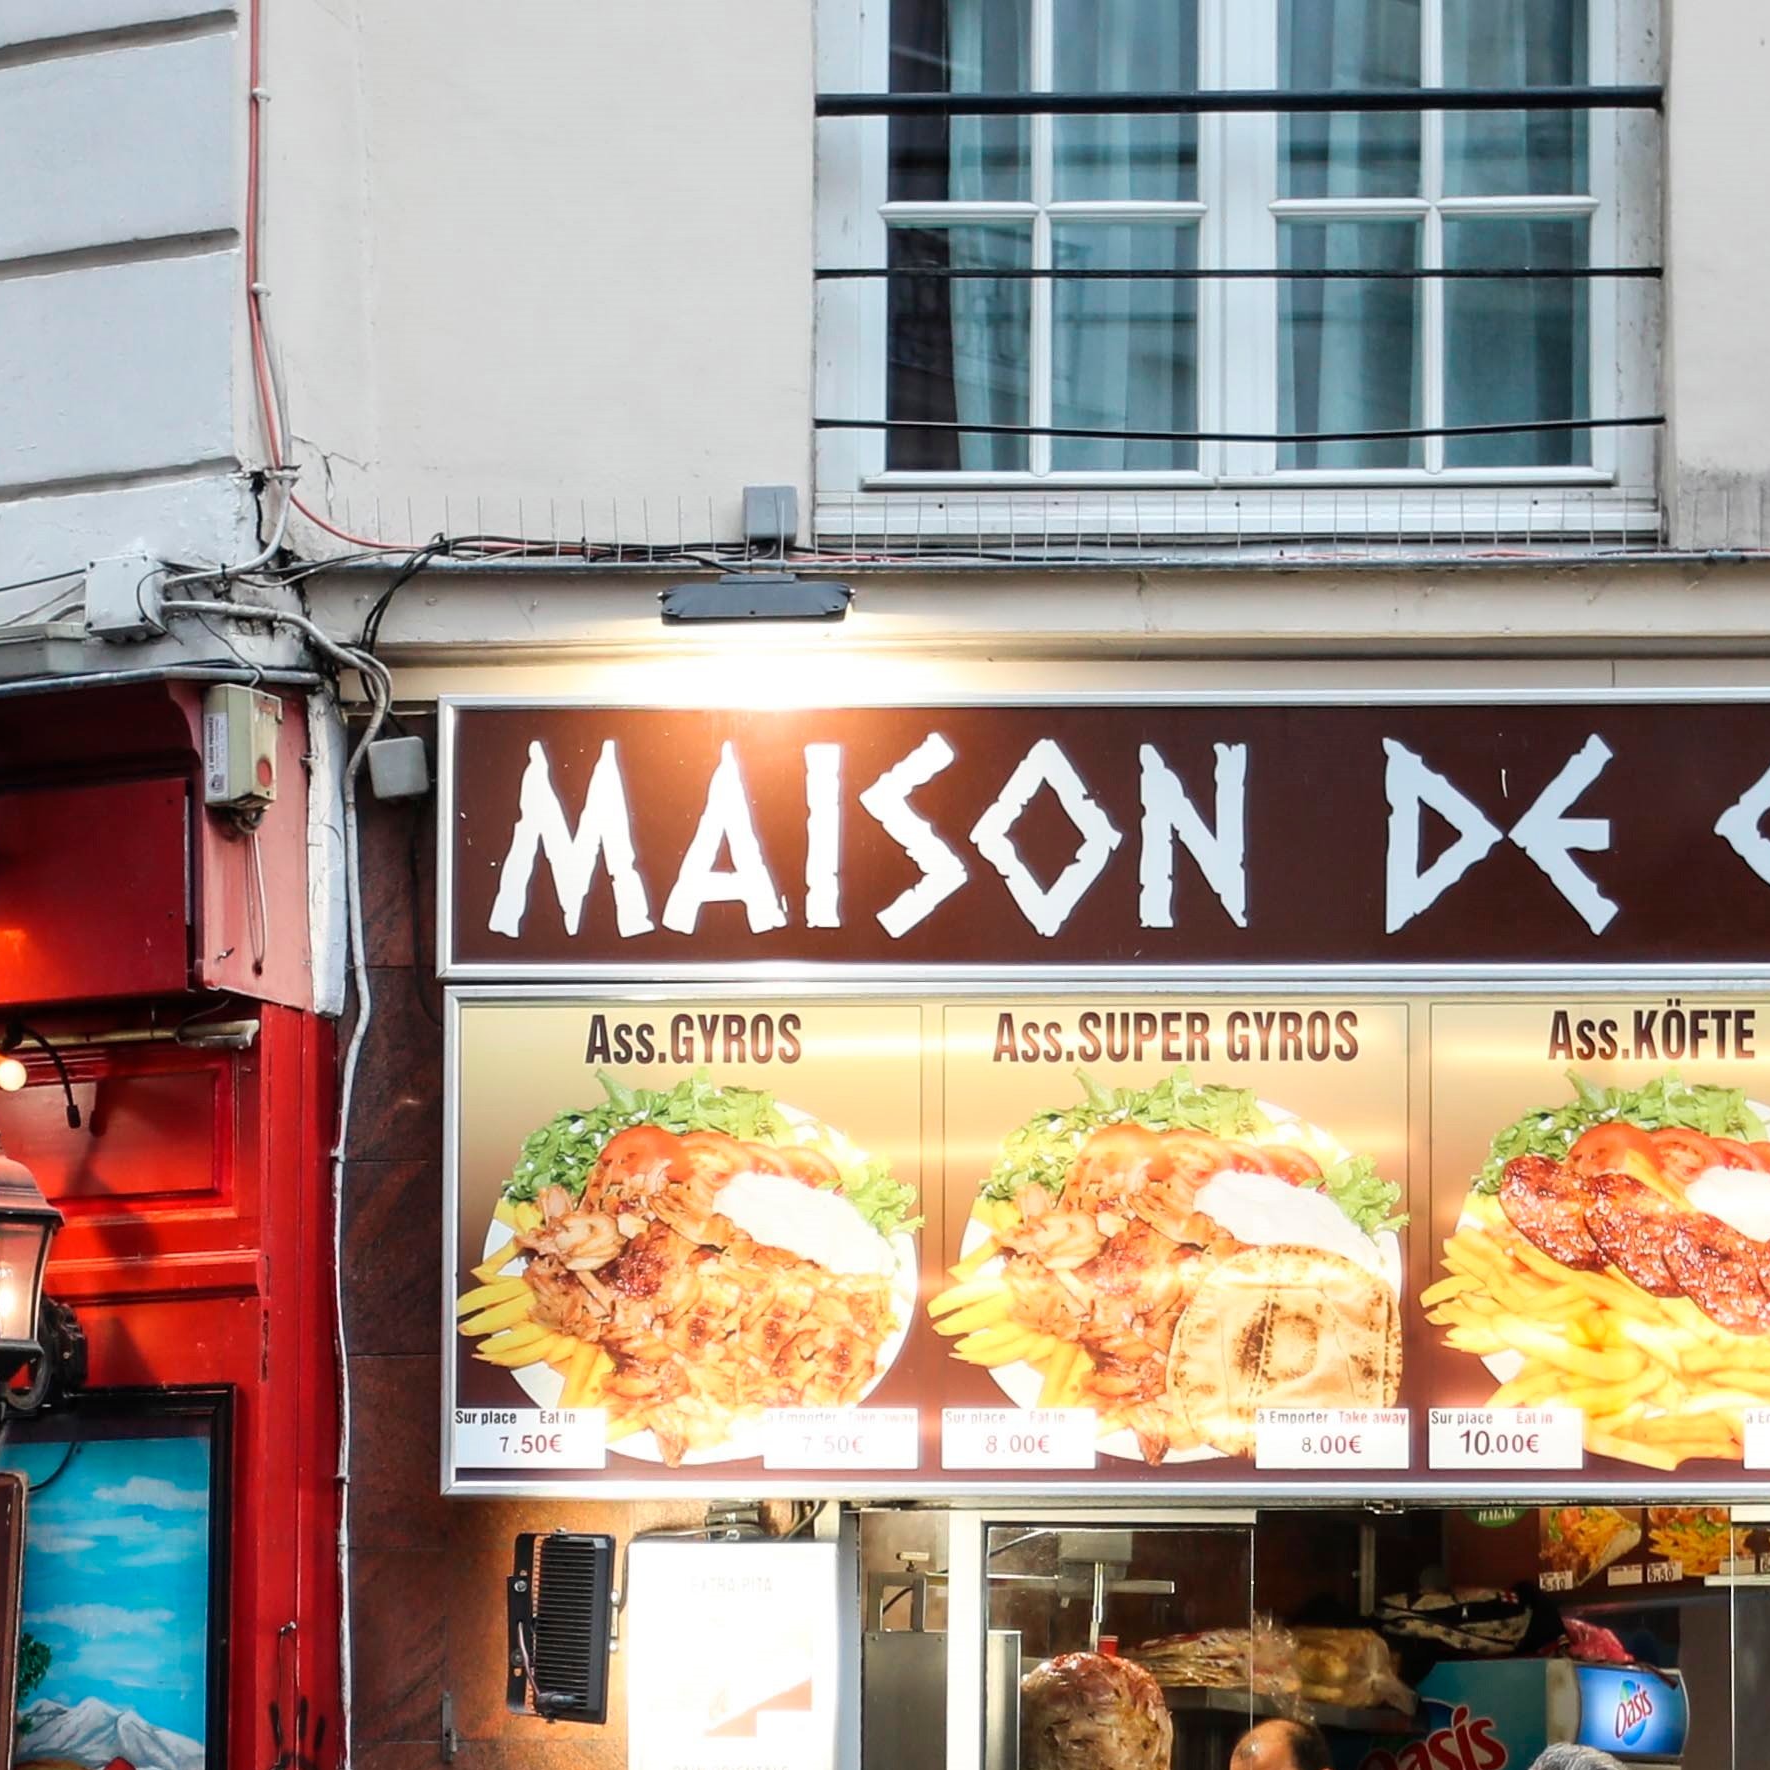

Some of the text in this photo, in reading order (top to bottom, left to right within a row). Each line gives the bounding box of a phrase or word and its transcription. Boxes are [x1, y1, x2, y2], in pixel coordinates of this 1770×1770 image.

[488, 732, 1249, 939] MAISON
[1381, 732, 1620, 938] DE
[1226, 1009, 1360, 1063] GYROS
[498, 1433, 564, 1455] 7.50€
[1301, 1434, 1363, 1455] 8.00€
[1458, 1429, 1541, 1456] 10.00€
[1613, 1684, 1654, 1742] Oasis
